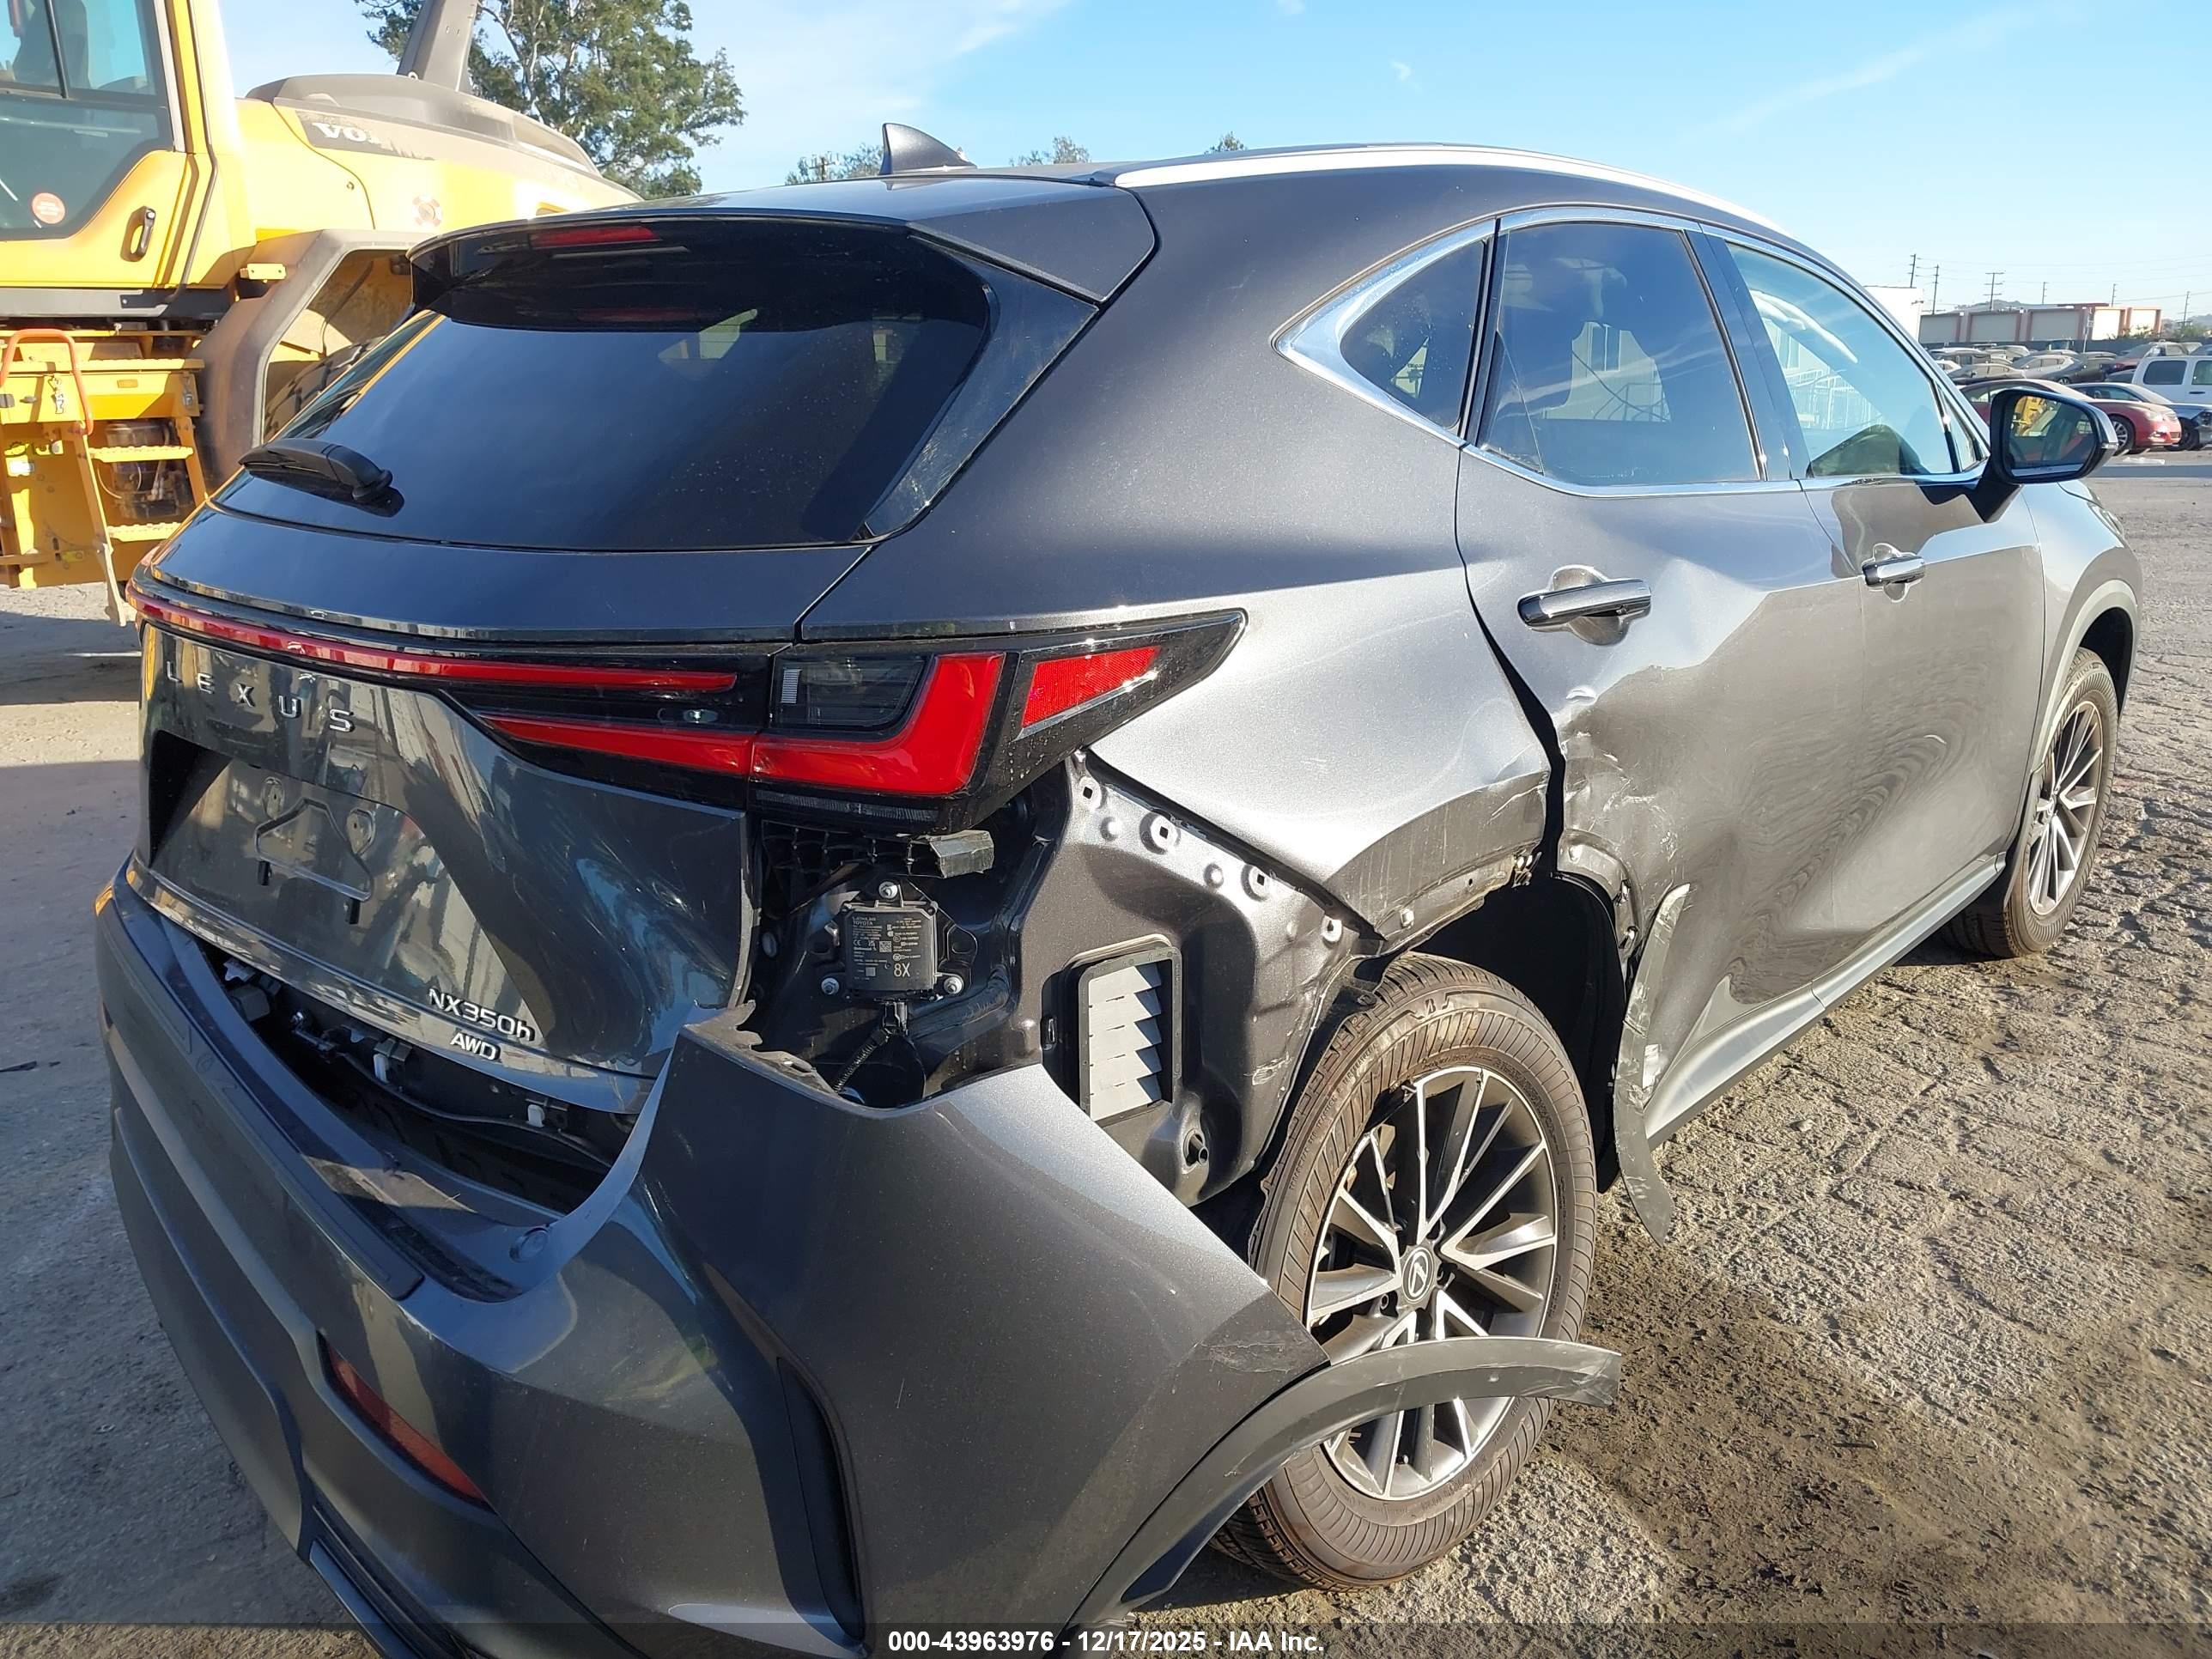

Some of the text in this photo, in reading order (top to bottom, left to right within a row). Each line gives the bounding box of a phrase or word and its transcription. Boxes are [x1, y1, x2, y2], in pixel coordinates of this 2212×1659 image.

[167, 660, 356, 732] LEXUS
[893, 962, 911, 978] 8X
[428, 988, 536, 1042] NX350h
[449, 1031, 502, 1061] AWD
